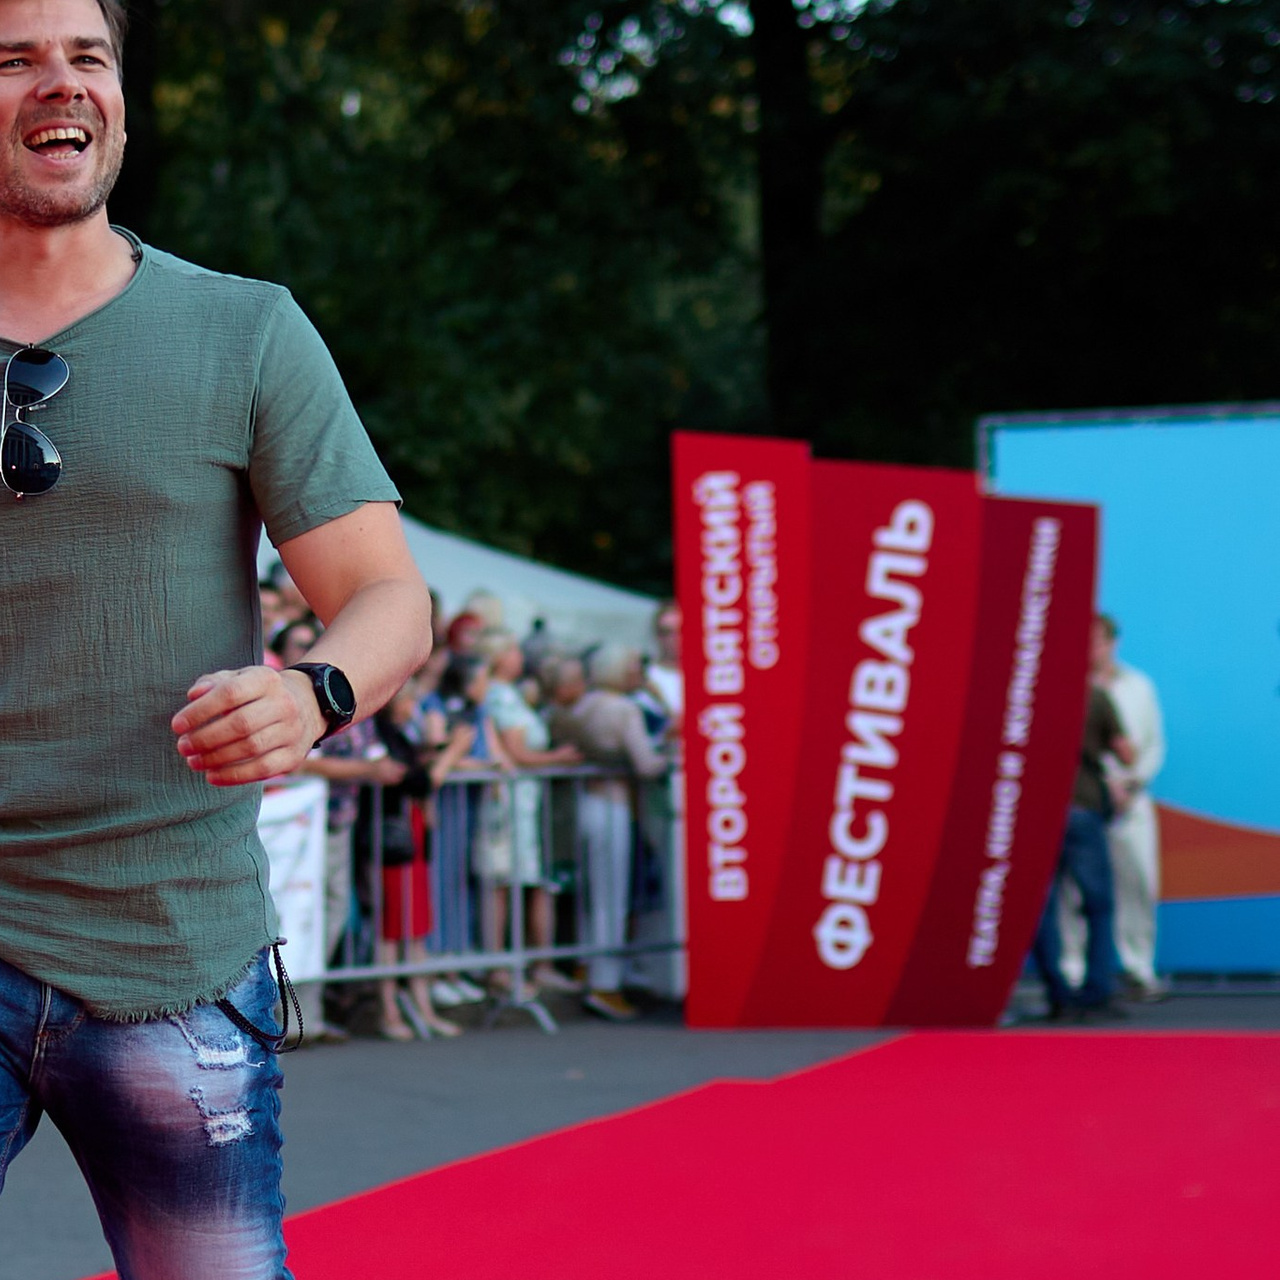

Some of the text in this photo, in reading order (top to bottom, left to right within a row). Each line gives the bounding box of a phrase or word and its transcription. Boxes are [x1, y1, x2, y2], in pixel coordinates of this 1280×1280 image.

[693, 471, 748, 901] ВТОРОЙ ВЯТСКИЙ
[743, 480, 779, 670] ОТКРЫТЫЙ
[813, 499, 934, 970] ФЕСТИВАЛЬ
